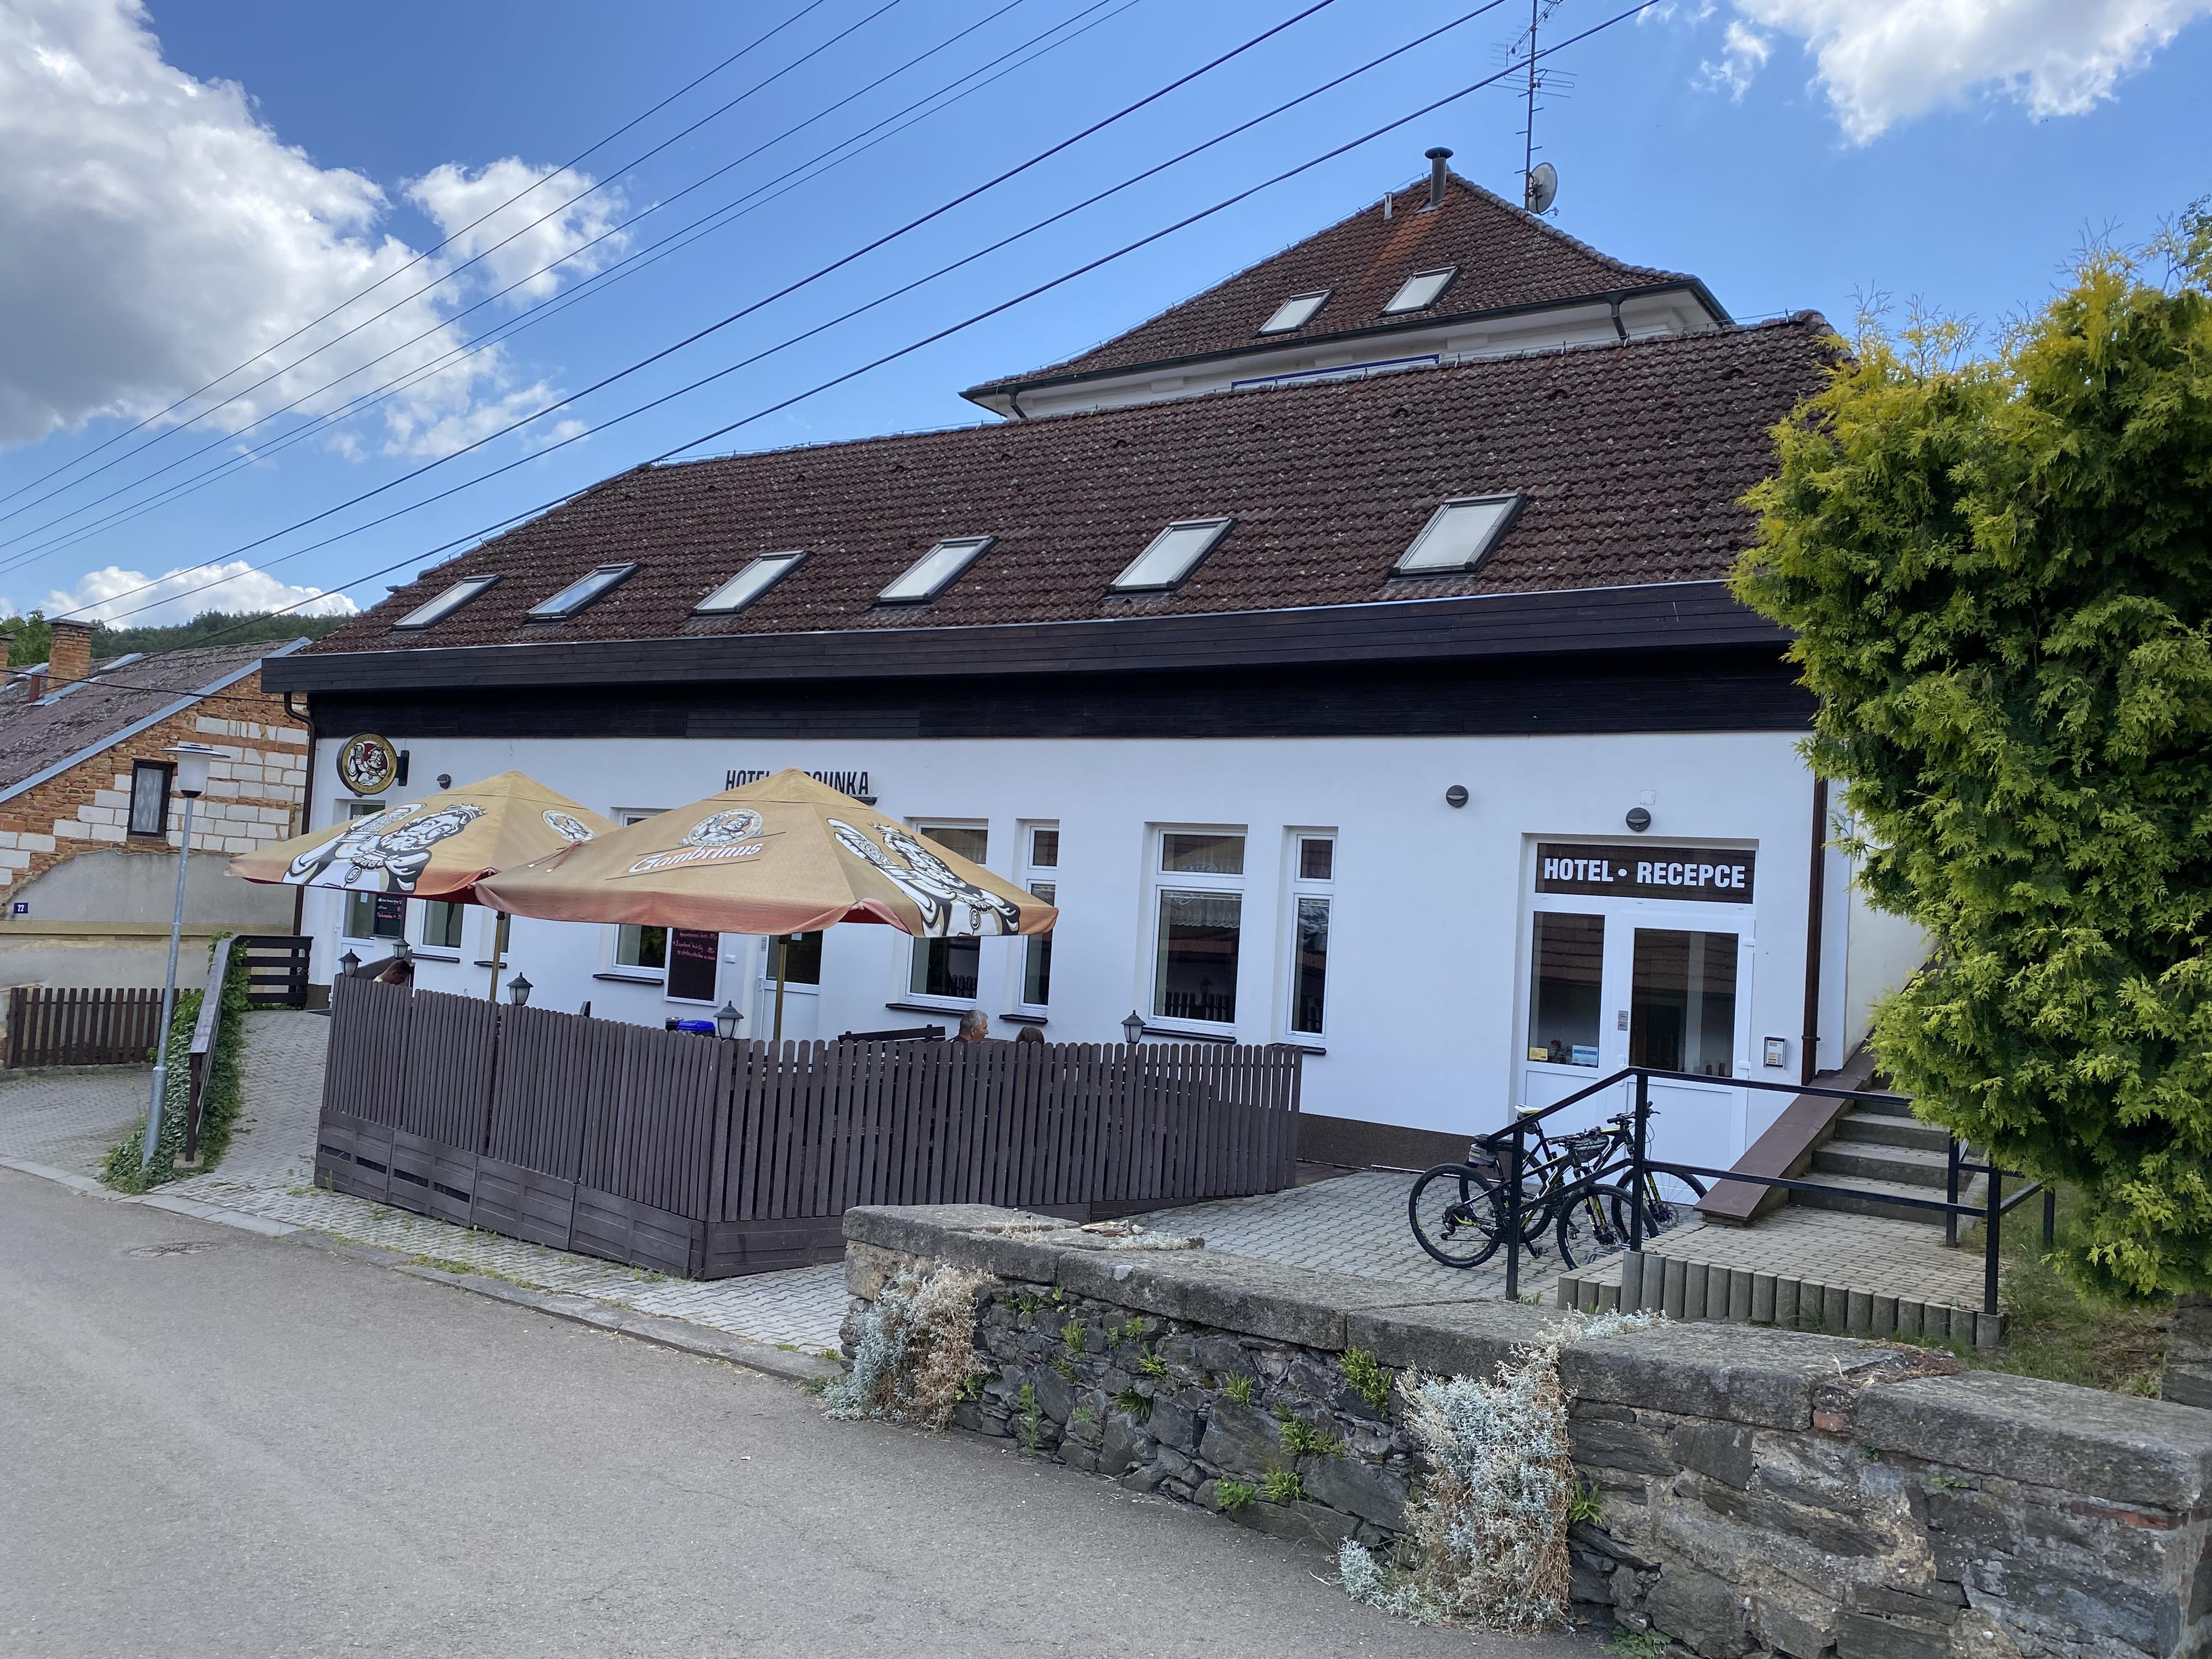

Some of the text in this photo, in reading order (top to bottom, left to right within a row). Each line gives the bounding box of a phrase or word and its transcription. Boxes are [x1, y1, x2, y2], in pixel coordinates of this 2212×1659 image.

[628, 843, 765, 873] Gambrinus
[1545, 858, 1745, 888] HOTEL RECEPCE
